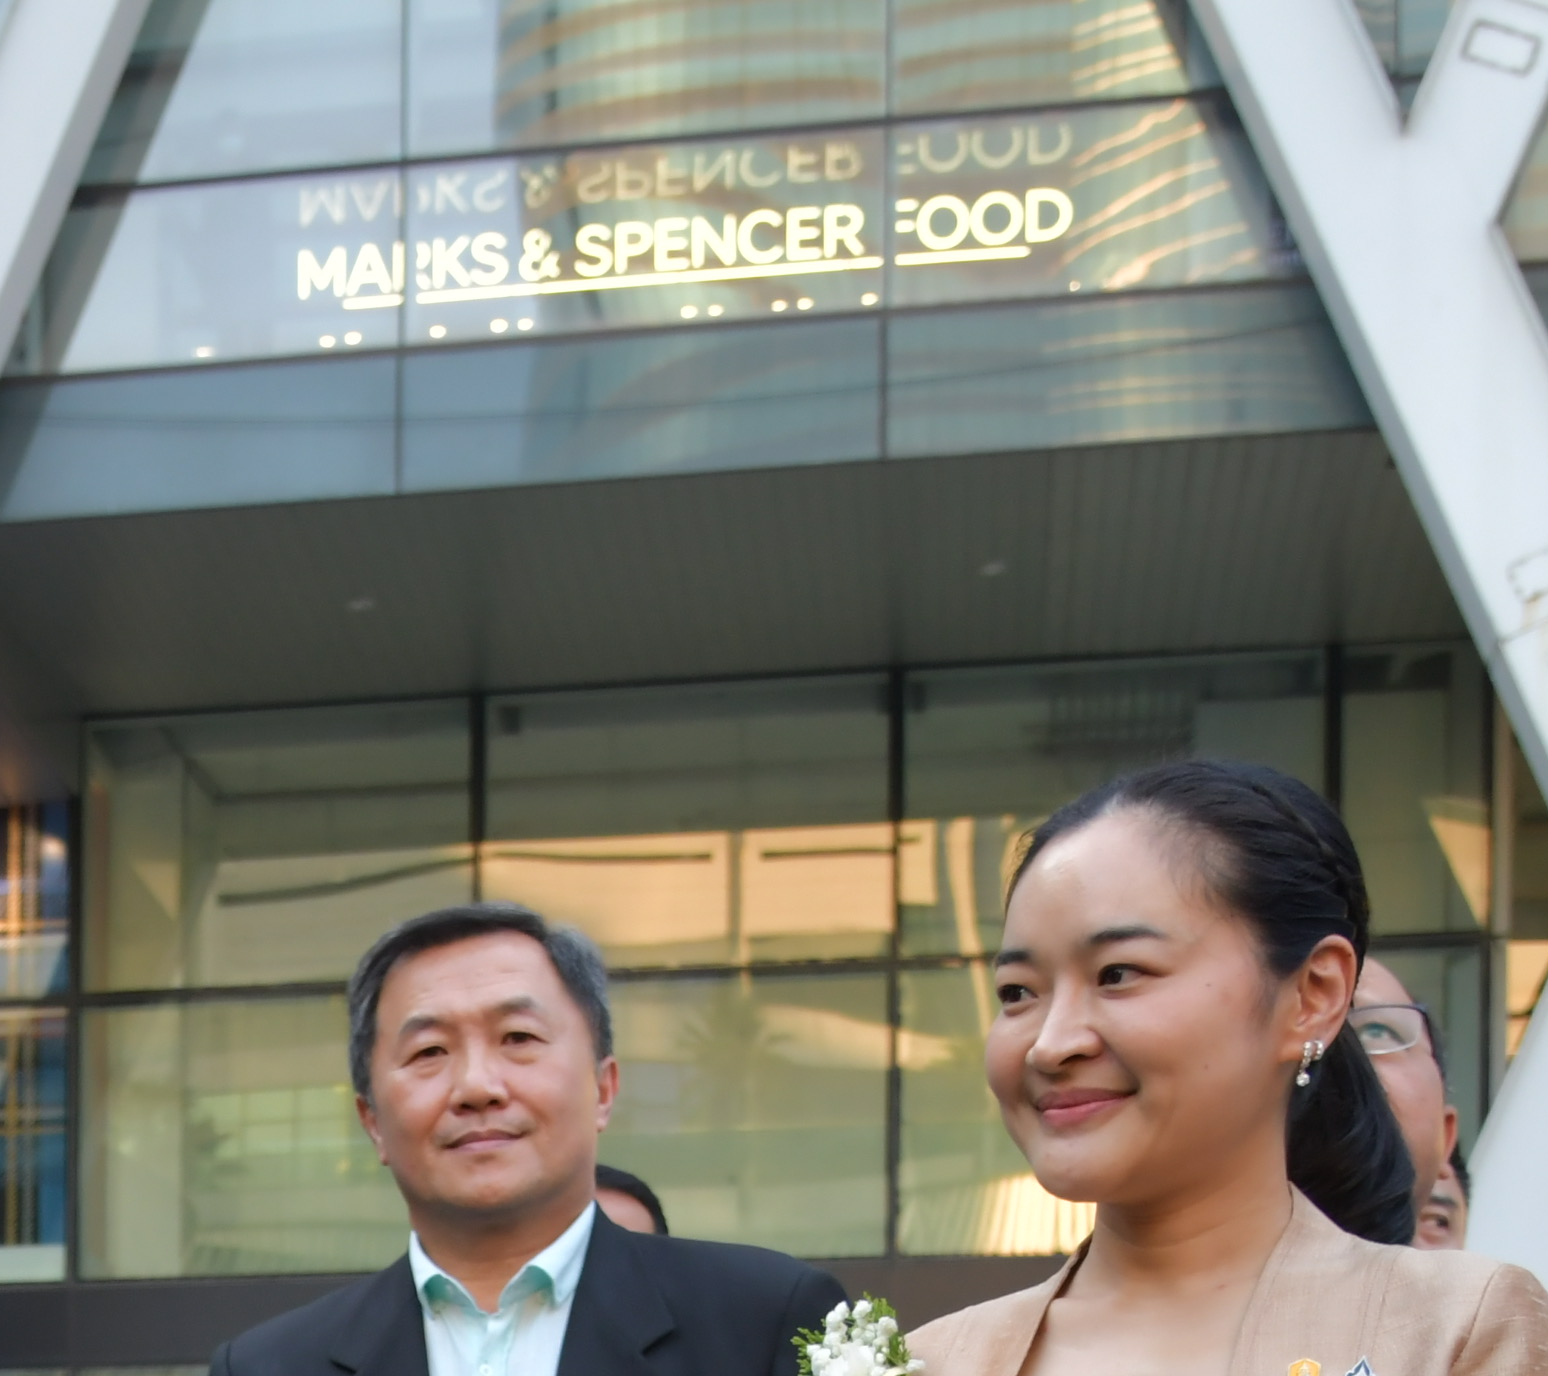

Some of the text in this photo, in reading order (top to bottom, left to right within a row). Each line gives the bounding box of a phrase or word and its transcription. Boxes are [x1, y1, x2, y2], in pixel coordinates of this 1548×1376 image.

[298, 188, 1074, 301] MARKS & SPENCER FOOD
